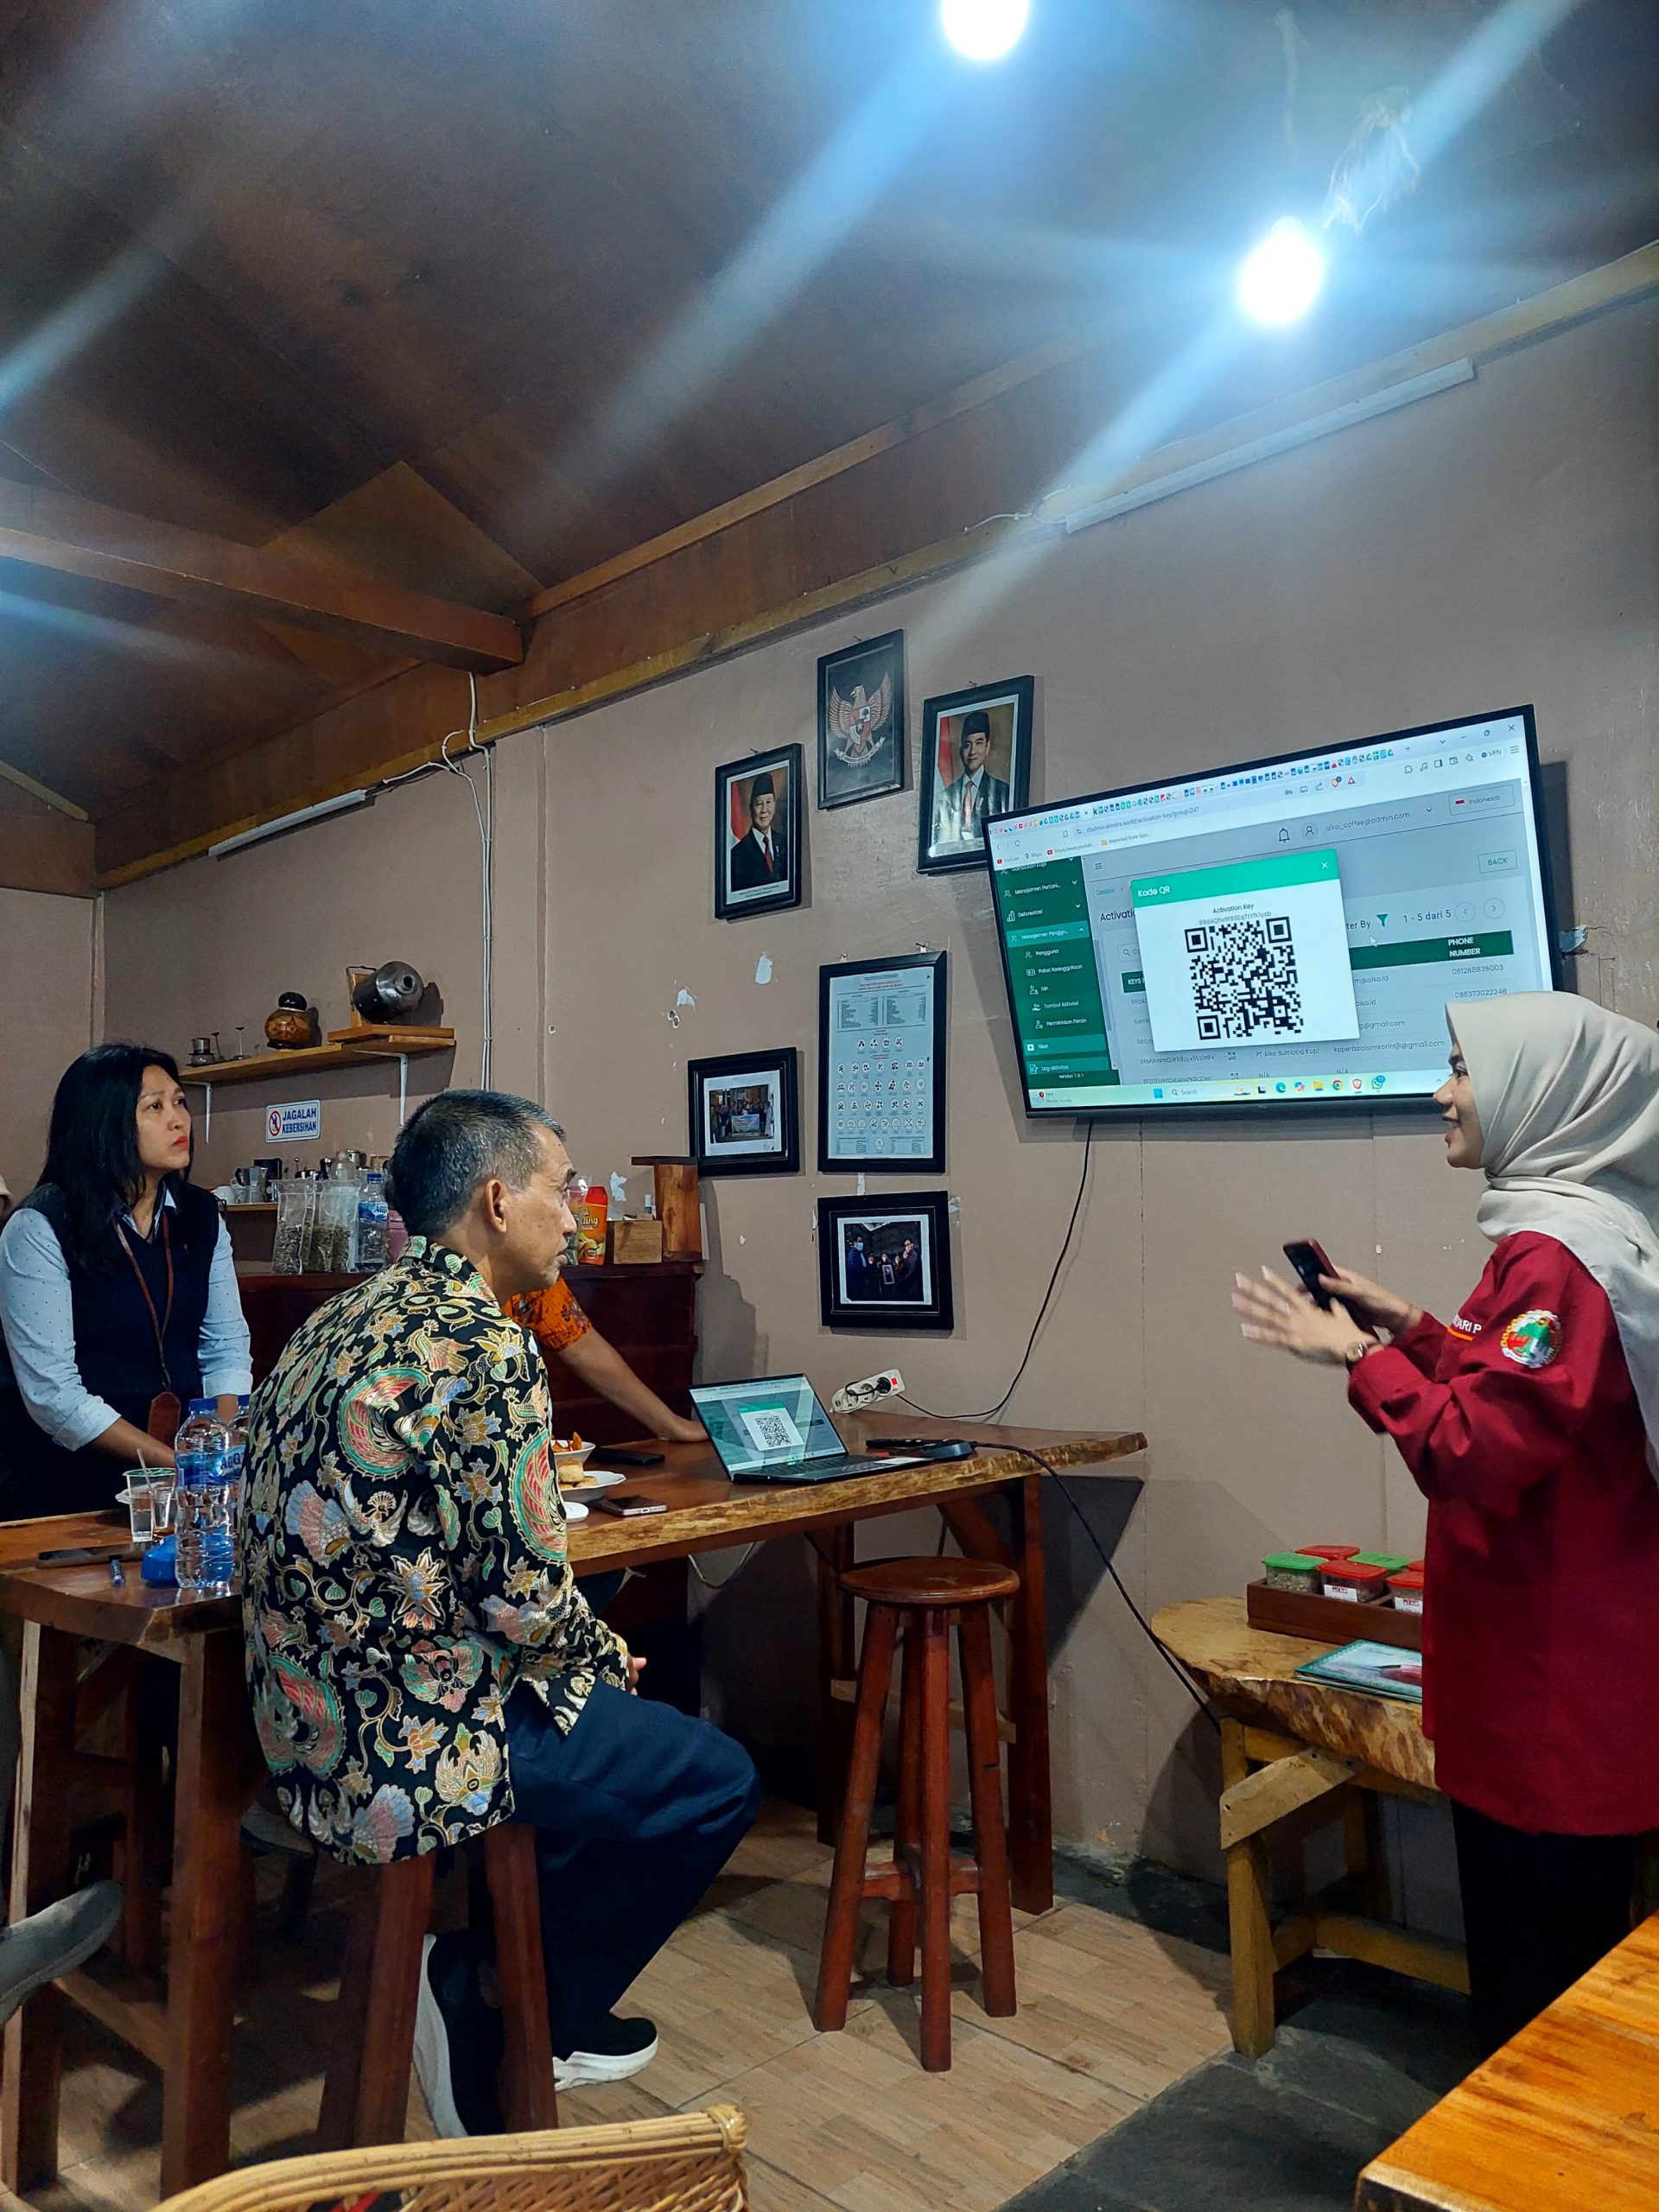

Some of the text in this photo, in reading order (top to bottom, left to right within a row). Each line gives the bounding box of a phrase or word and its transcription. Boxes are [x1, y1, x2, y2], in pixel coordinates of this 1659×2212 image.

[1488, 747, 1502, 757] VPN
[1468, 794, 1501, 804] Indonesia
[1488, 856, 1508, 866] BACK
[1137, 886, 1171, 898] Kode QR
[1212, 905, 1243, 913] Activation
[1402, 914, 1408, 923] 1
[1426, 911, 1443, 920] dari
[1346, 919, 1371, 930] ter By
[1447, 937, 1474, 946] PHONE
[1449, 947, 1481, 957] NUMBER
[1353, 975, 1389, 985] m@alko.id
[1359, 1020, 1406, 1031] g@gmail.com
[283, 1108, 316, 1121] JAGALAH
[283, 1121, 316, 1134] KEBERSIHAN
